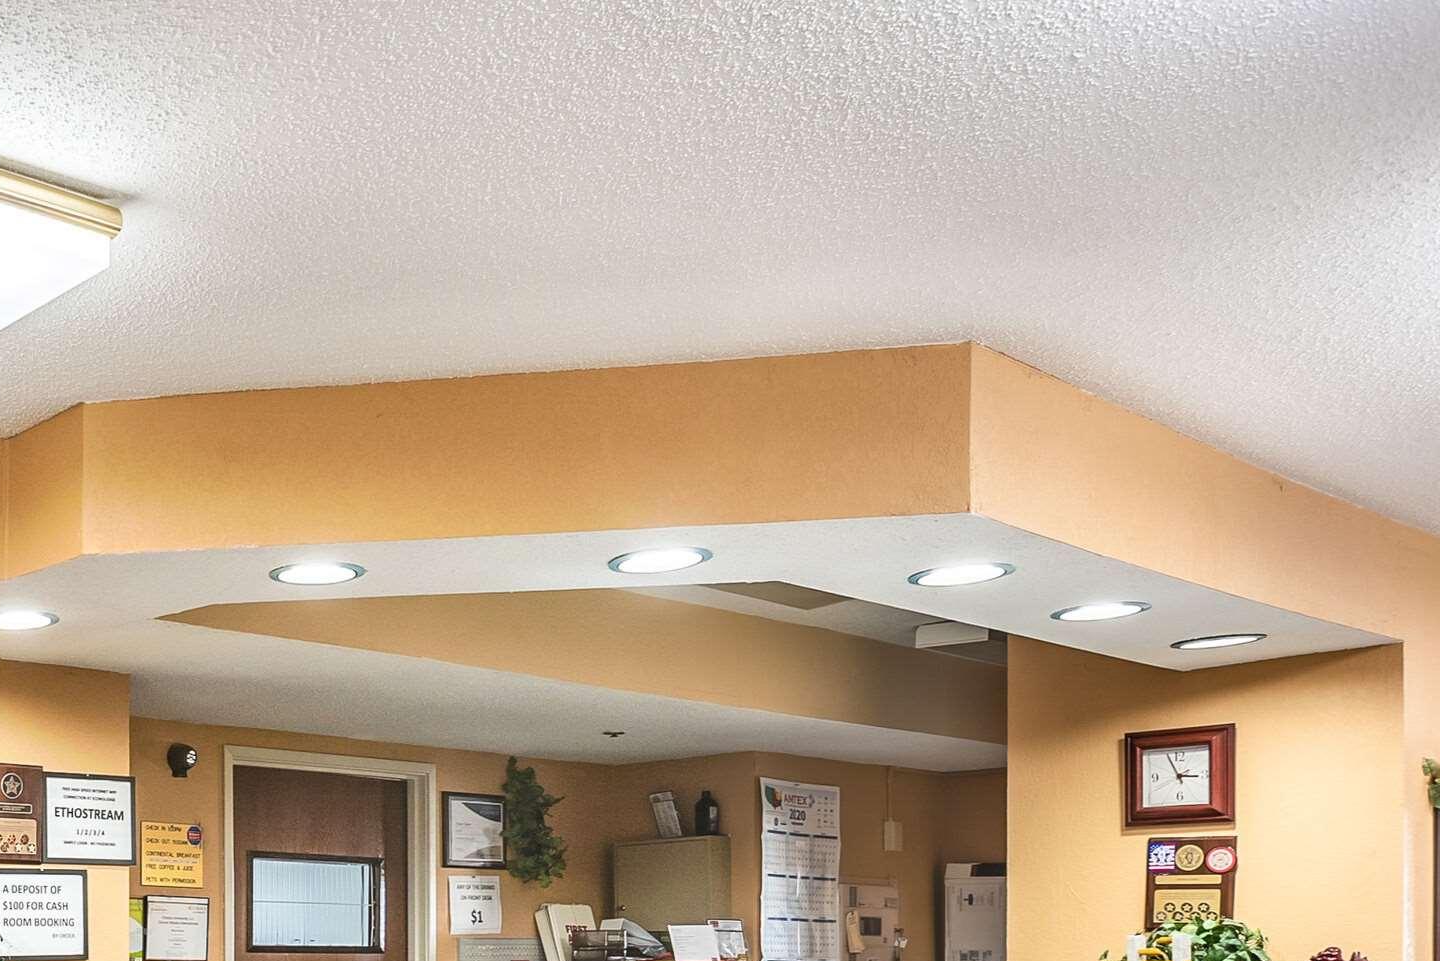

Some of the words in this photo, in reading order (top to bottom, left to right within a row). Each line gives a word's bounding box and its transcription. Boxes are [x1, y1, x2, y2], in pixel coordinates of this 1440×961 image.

[1174, 751, 1185, 762] 12
[1151, 773, 1159, 783] 9
[1201, 769, 1209, 779] 3
[1176, 791, 1184, 801] 6
[54, 806, 124, 821] ETHOSTREAM
[2, 884, 9, 894] A
[11, 885, 48, 894] DEPOSIT
[50, 885, 62, 894] OF
[2, 901, 24, 911] $100
[26, 902, 44, 910] FOR
[46, 902, 69, 911] CASH
[471, 909, 483, 925] $1
[3, 918, 32, 927] ROOM
[34, 918, 75, 927] BOOKING
